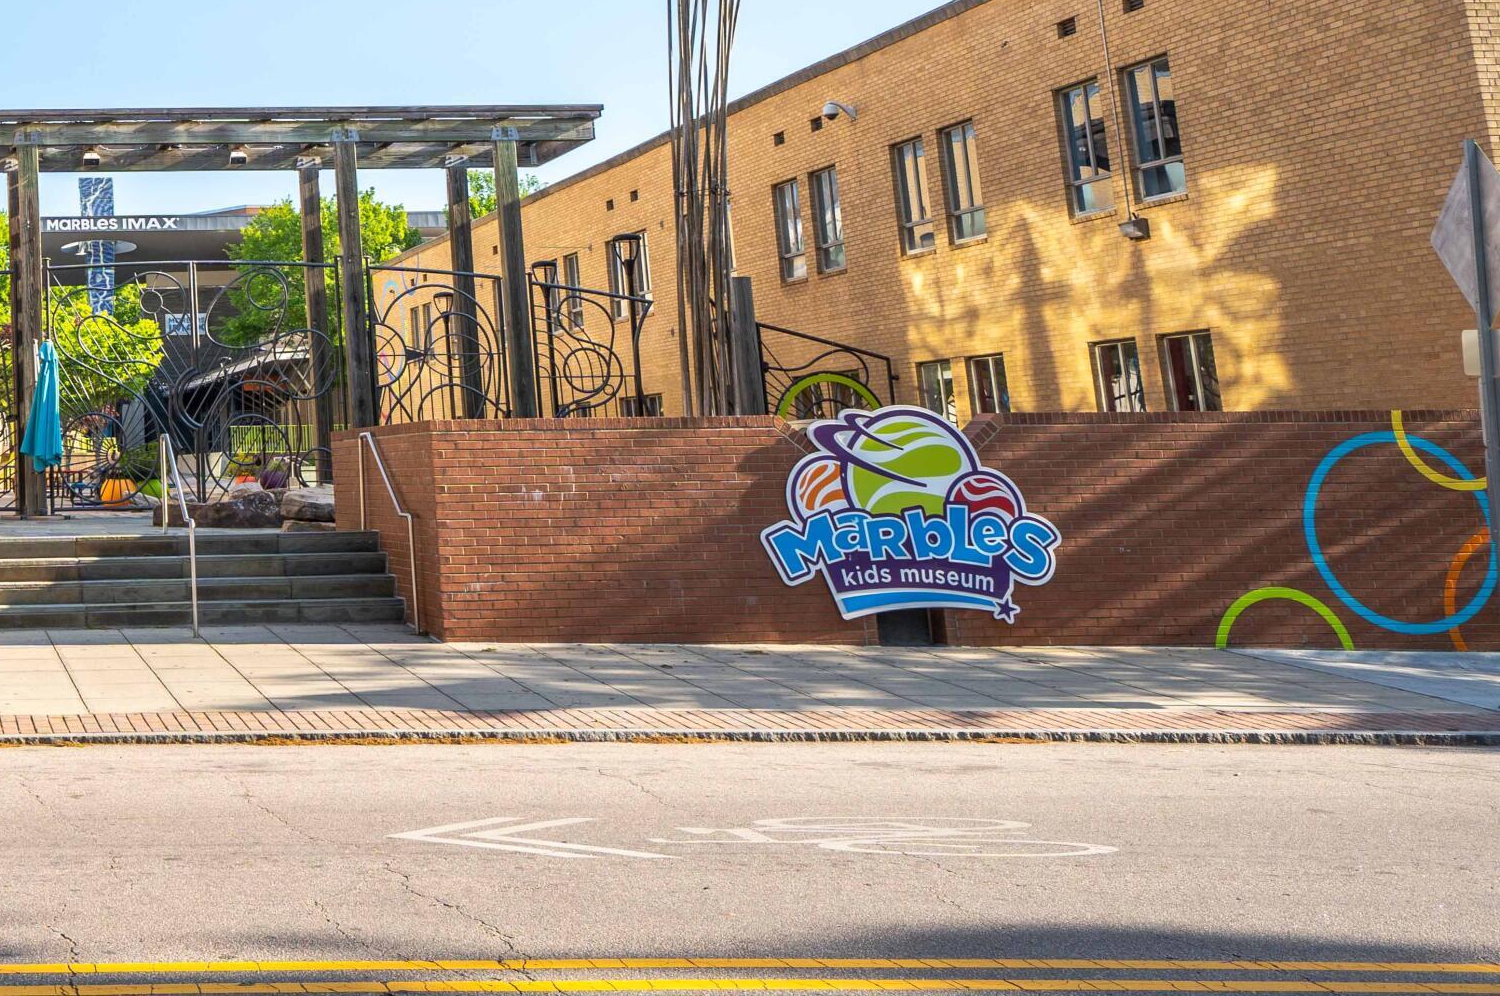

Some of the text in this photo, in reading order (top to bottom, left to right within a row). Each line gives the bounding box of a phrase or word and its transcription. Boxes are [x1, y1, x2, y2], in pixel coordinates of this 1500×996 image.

[122, 217, 178, 229] IMAX
[841, 565, 995, 592] kids museum
